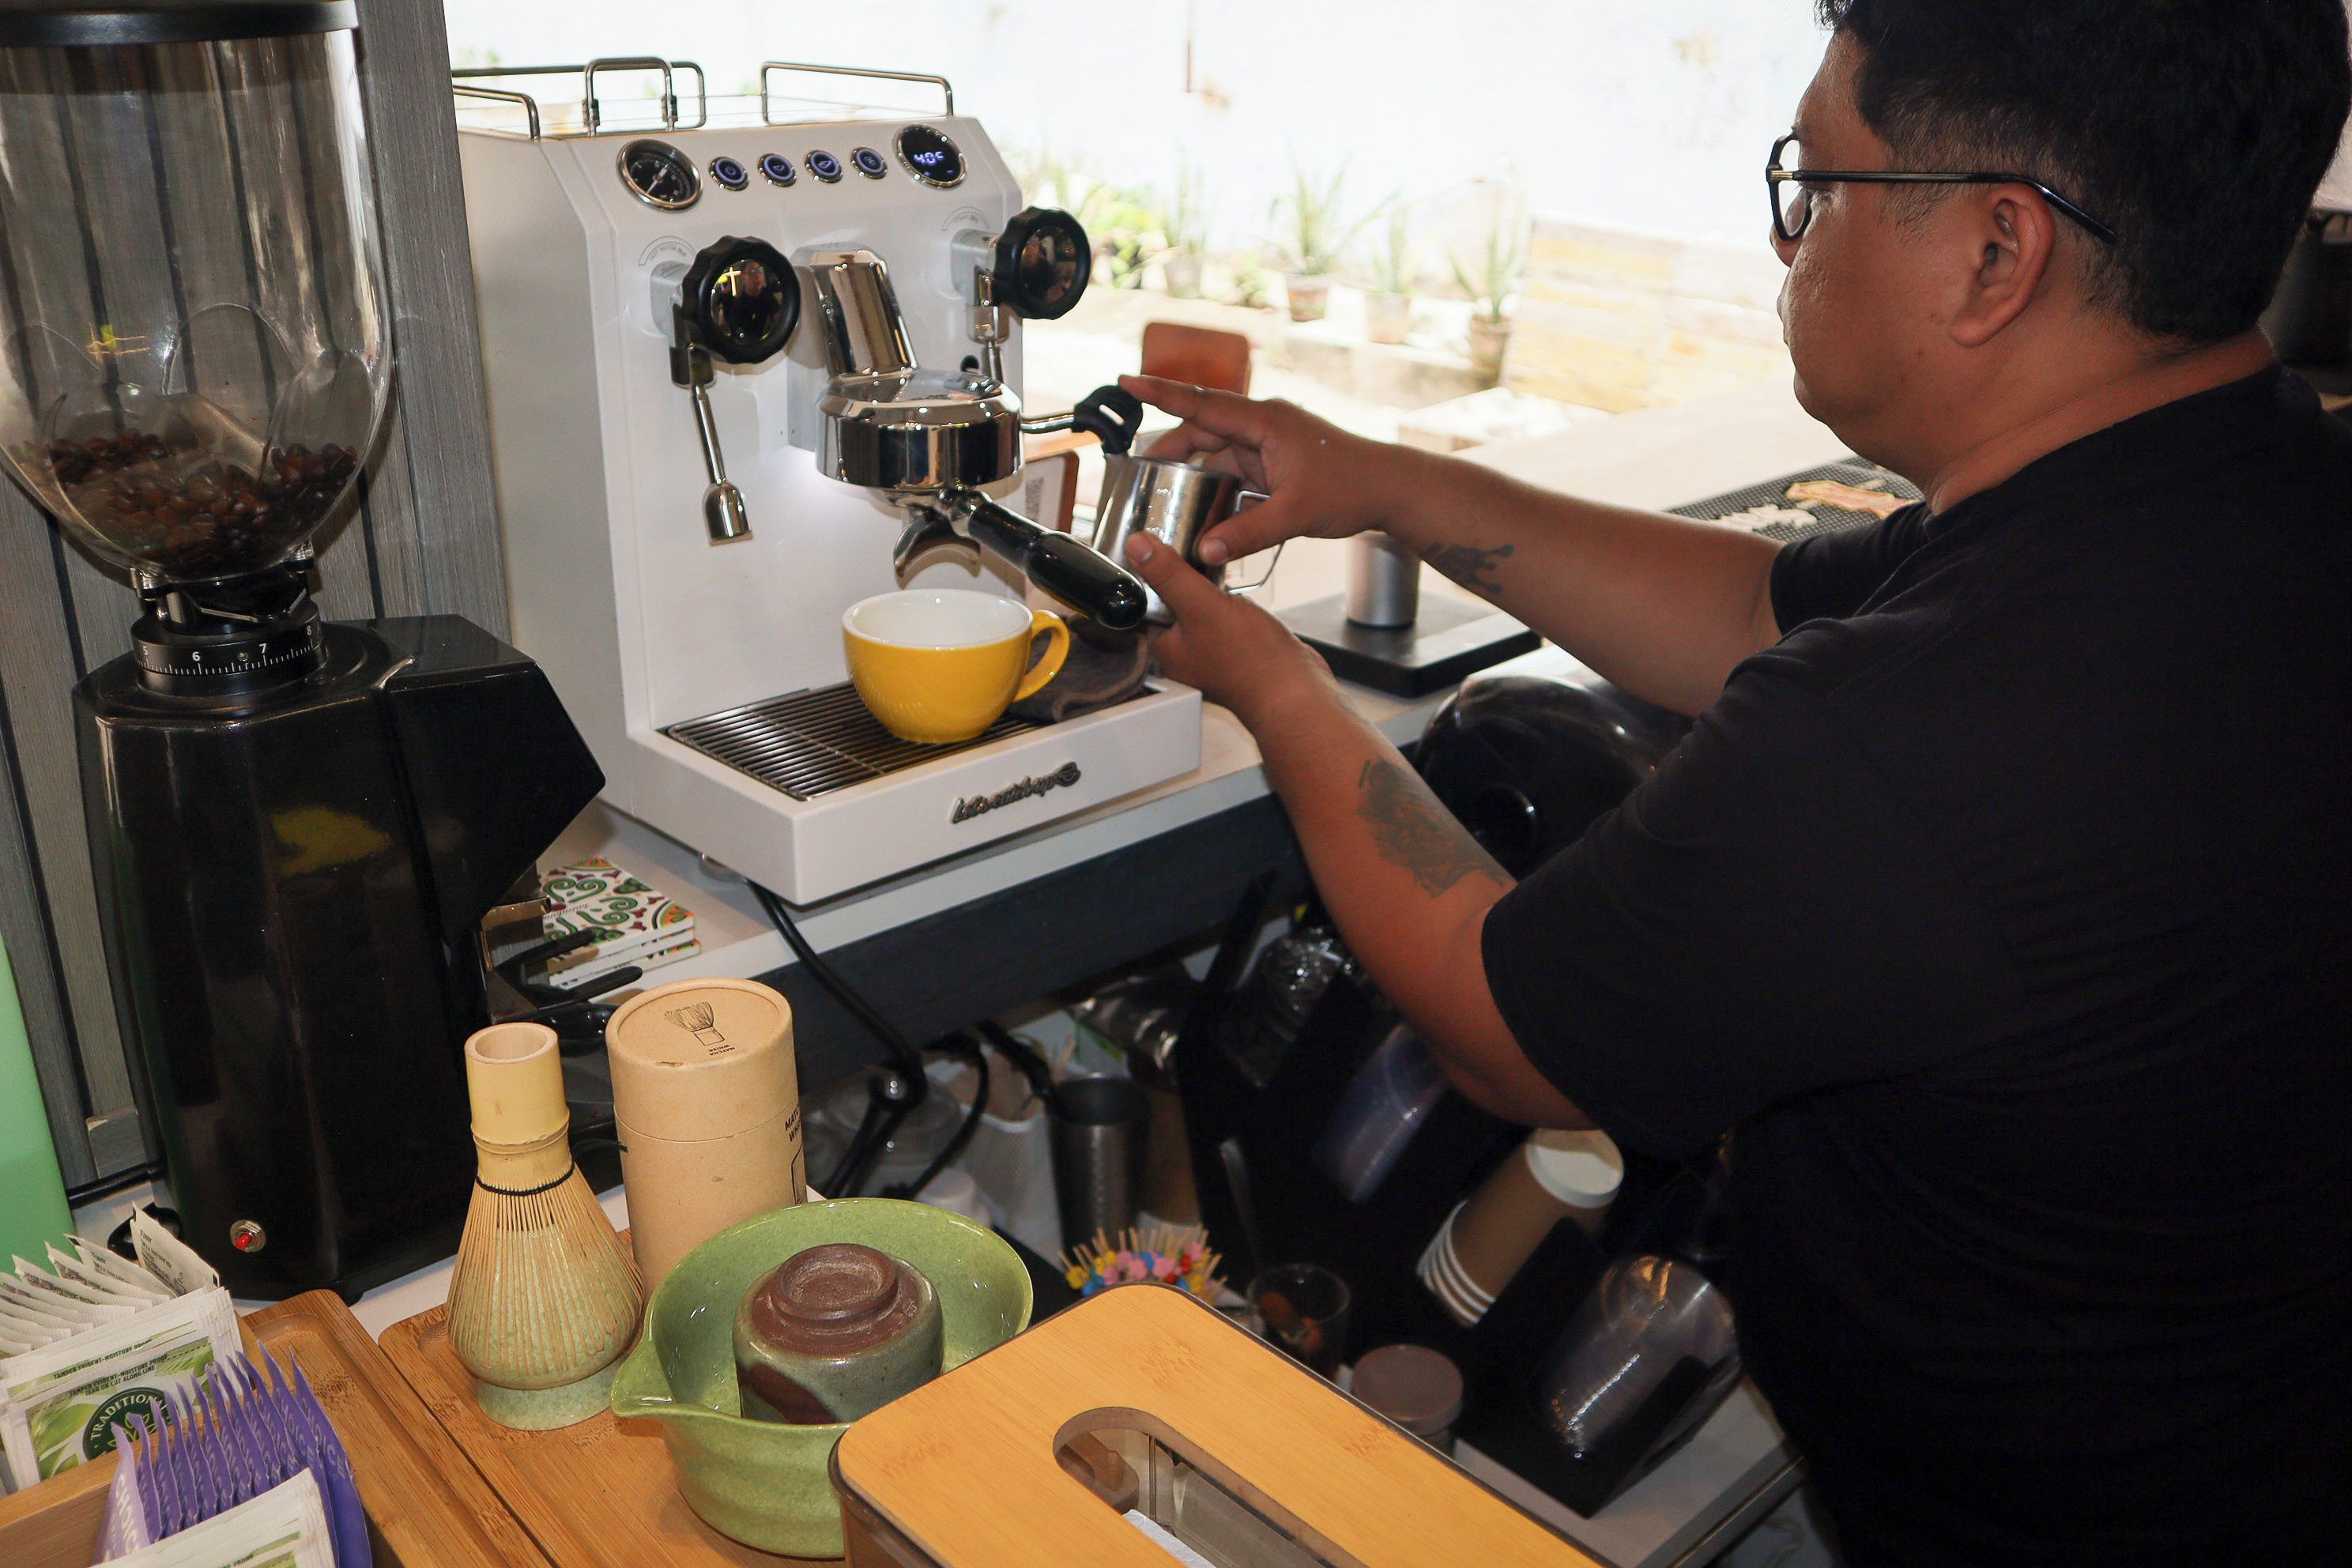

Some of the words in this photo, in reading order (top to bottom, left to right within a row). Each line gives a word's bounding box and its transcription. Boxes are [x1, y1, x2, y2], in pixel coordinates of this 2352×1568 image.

[142, 645, 149, 656] 5
[192, 651, 201, 662] 6
[258, 643, 267, 654] 7
[307, 625, 312, 636] 8
[709, 1047, 735, 1056] MATCHA
[53, 1366, 77, 1379] TAMPER
[70, 1383, 92, 1397] TAMPER
[93, 1361, 149, 1387] EVIDENT-MOISTURE
[149, 1353, 168, 1367] PROOF
[85, 1387, 100, 1396] TEAR
[122, 1370, 141, 1382] ALONG
[142, 1365, 156, 1374] LINE
